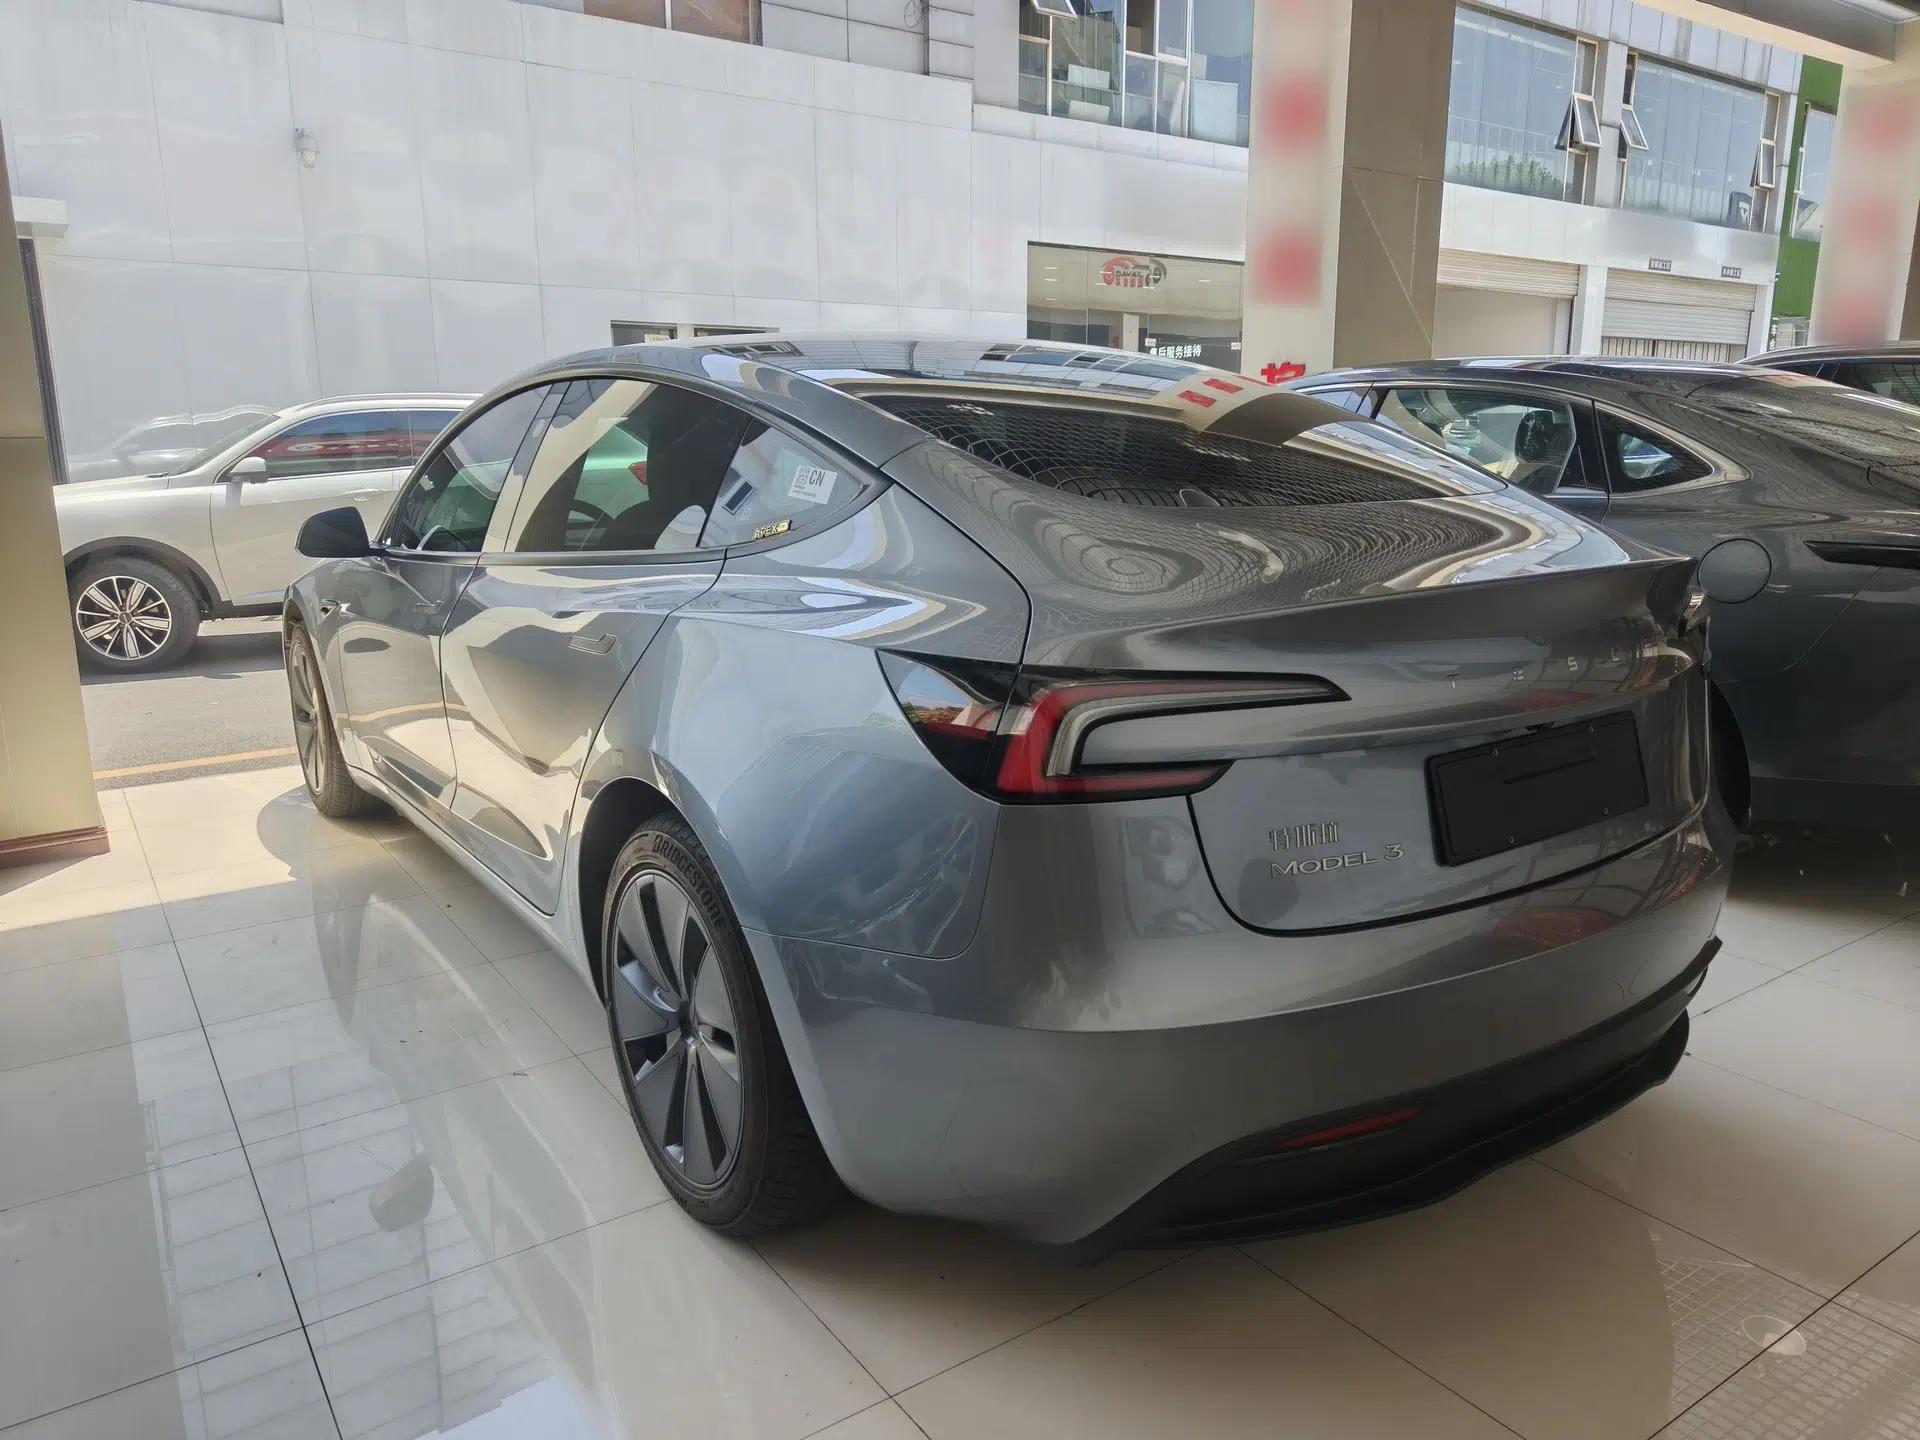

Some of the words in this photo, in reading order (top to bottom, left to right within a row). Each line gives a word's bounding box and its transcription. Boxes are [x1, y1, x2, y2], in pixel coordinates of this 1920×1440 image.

[809, 469, 826, 487] CN
[1270, 851, 1380, 880] MODEL
[1384, 842, 1404, 860] 3
[652, 834, 727, 932] BRIDGESTONE
